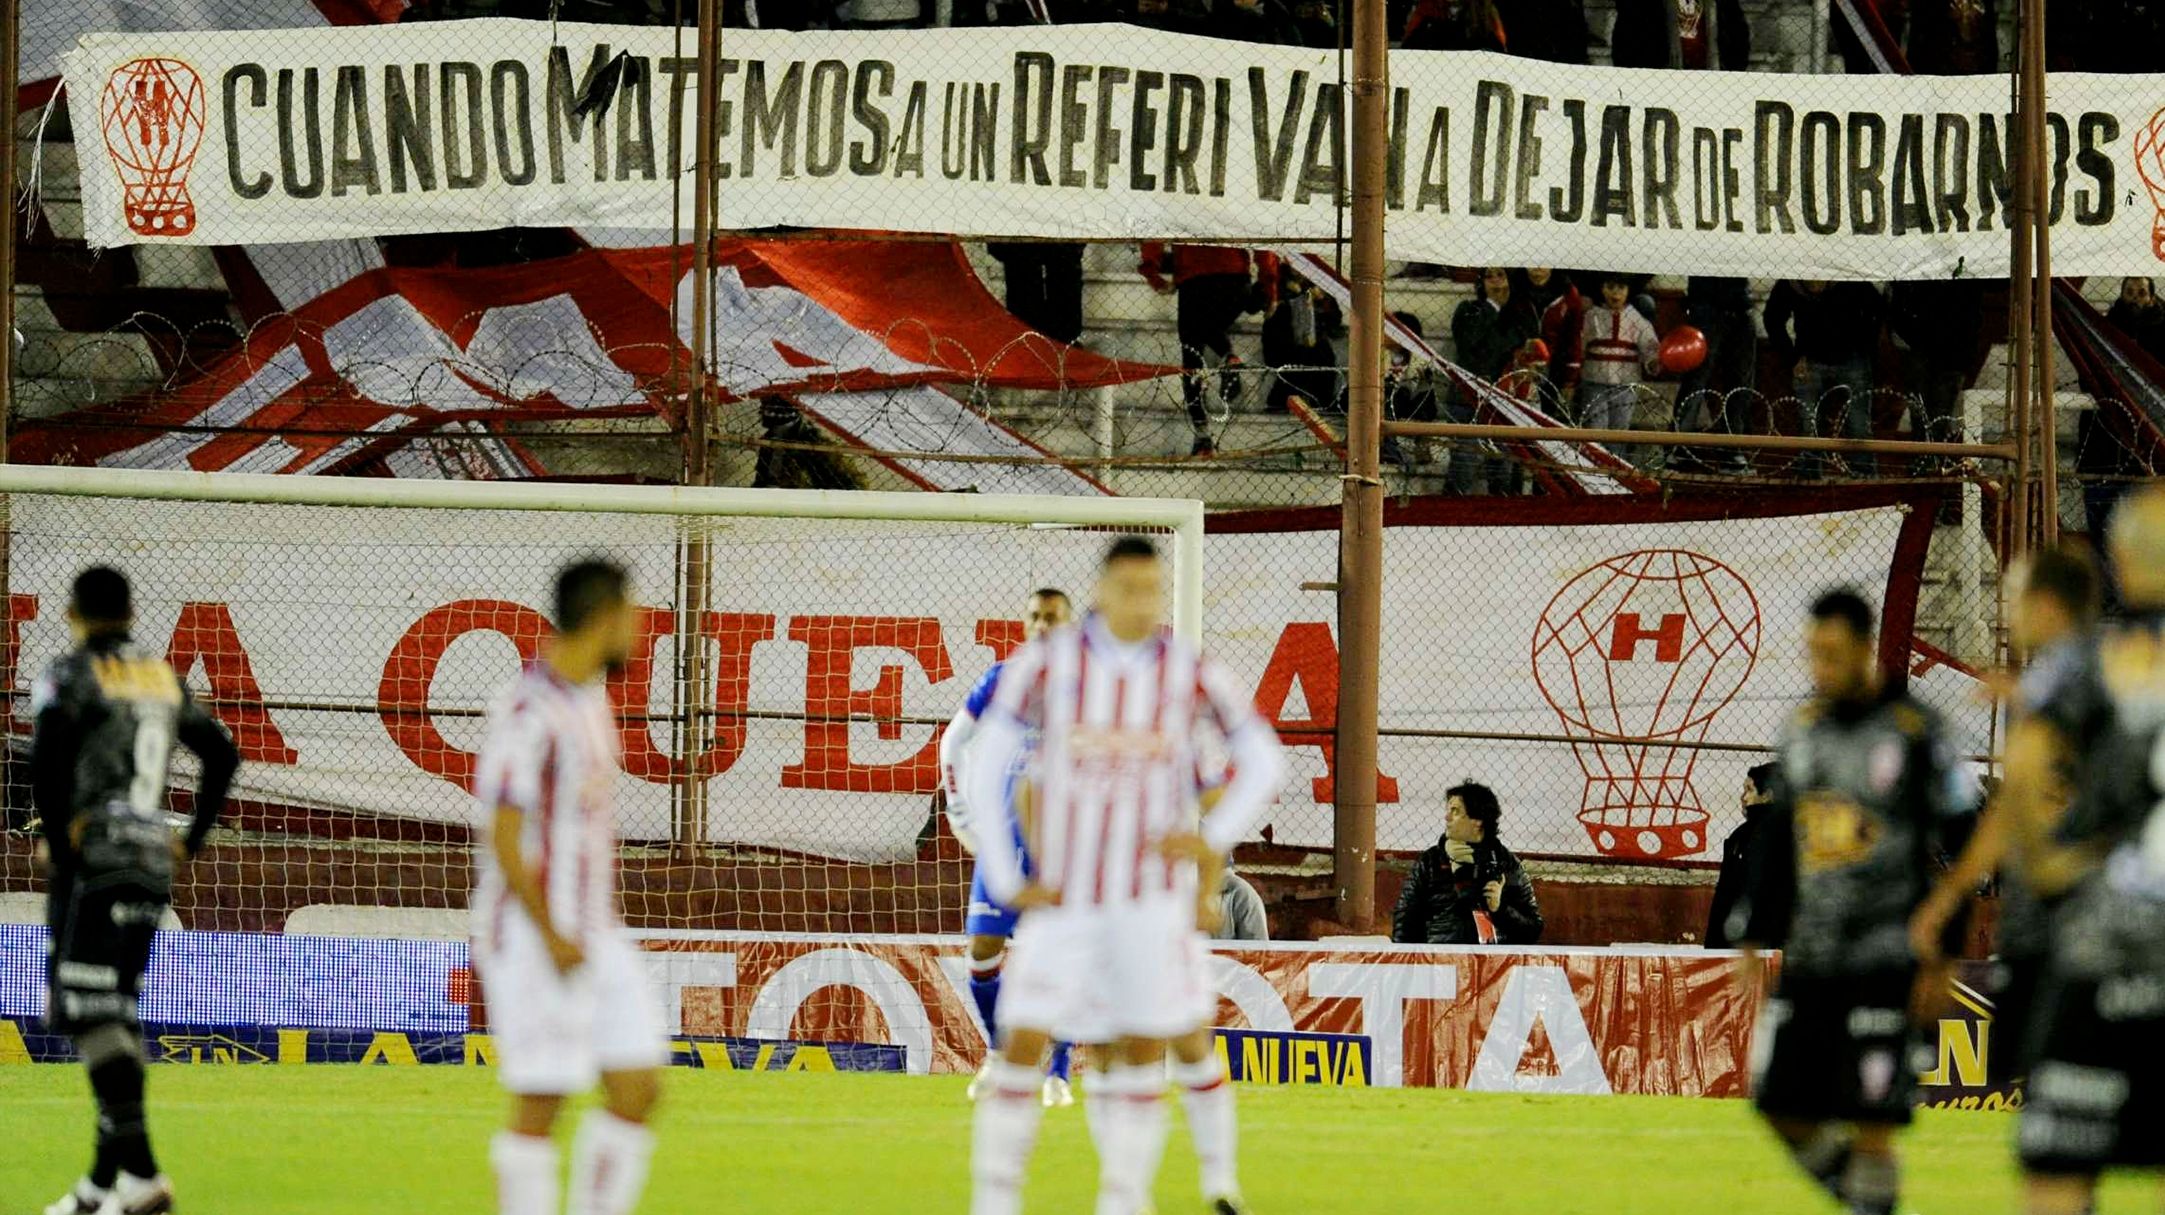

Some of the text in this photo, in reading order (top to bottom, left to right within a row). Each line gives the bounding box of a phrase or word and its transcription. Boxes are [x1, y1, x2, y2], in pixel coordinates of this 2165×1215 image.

[222, 59, 535, 199] CUANDO
[546, 43, 895, 184] MATEMOS
[894, 81, 925, 178] A
[942, 82, 1000, 182] UN
[1010, 51, 1231, 196] REFERI
[1415, 106, 1449, 213] A
[1468, 80, 1683, 230] DEJAR
[1693, 126, 1743, 232] DE
[1754, 100, 2120, 236] ROBARNOS
[1609, 613, 1686, 662] H
[378, 598, 1400, 803] QUEA
[1242, 1036, 1366, 1088] NUEVA
